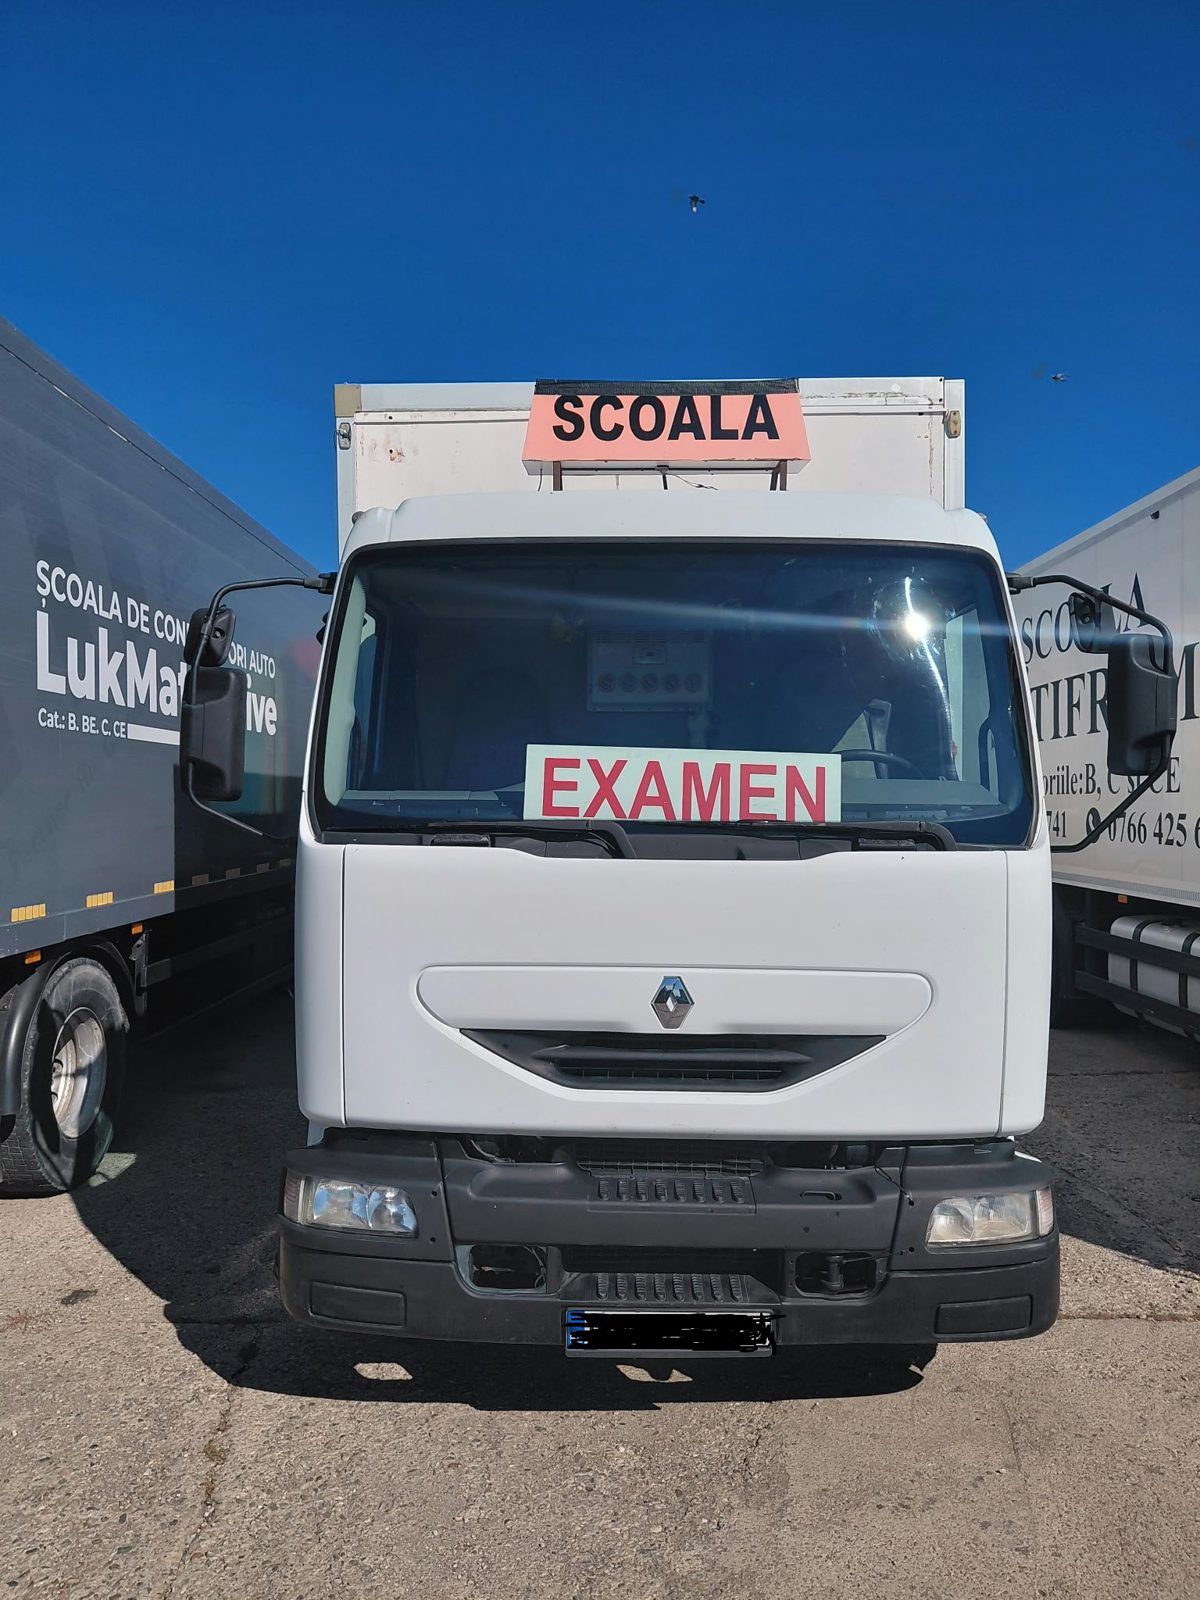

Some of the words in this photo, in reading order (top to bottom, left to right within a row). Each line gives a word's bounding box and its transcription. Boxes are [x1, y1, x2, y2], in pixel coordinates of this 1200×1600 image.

[552, 394, 780, 442] SCOALA
[127, 597, 149, 634] DE
[249, 649, 276, 679] AUTO
[113, 720, 126, 739] CE
[542, 757, 827, 824] EXAMEN
[1153, 812, 1187, 848] 425
